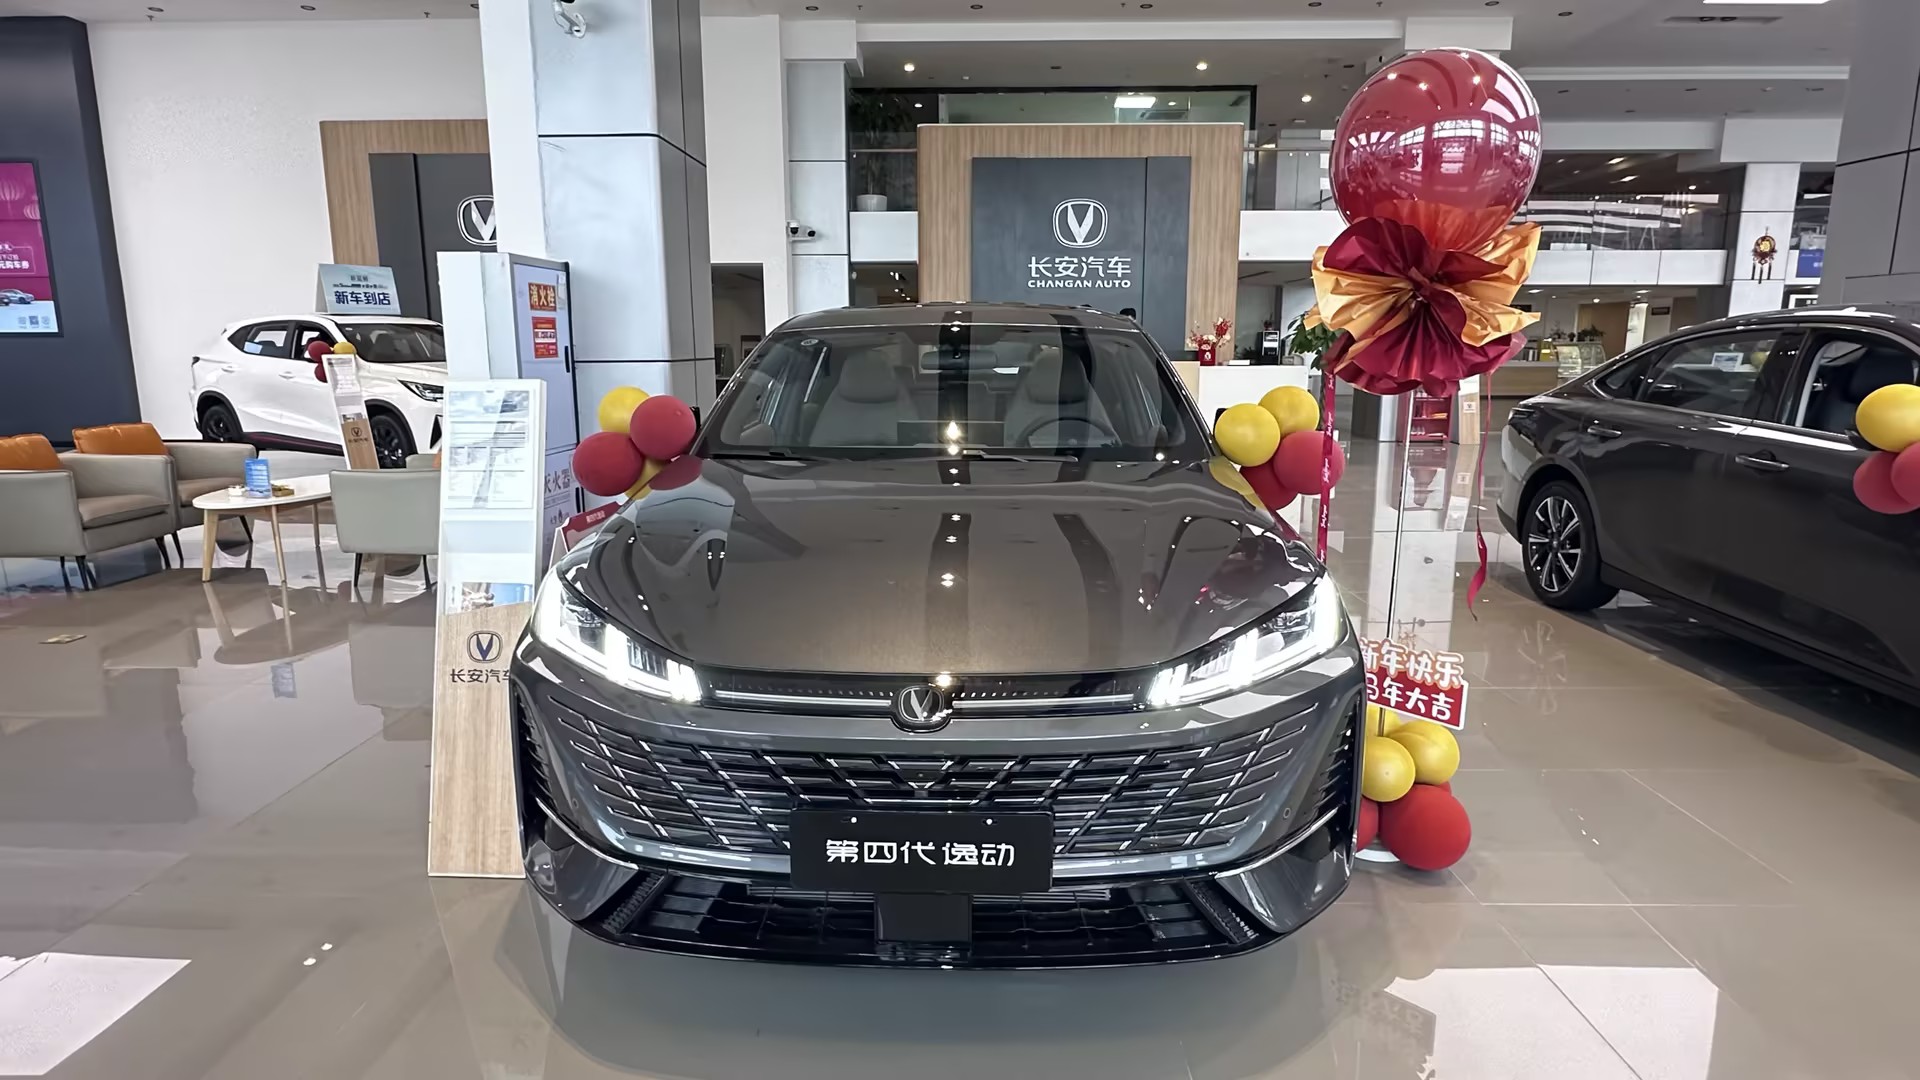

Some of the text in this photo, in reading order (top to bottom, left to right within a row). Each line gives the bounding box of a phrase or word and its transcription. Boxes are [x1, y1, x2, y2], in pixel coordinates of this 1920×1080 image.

[1028, 256, 1131, 277] 长安汽车
[1028, 280, 1131, 288] CHANGAN AUTO
[334, 291, 391, 305] 新车到店
[826, 839, 1015, 867] 第四代逸动
